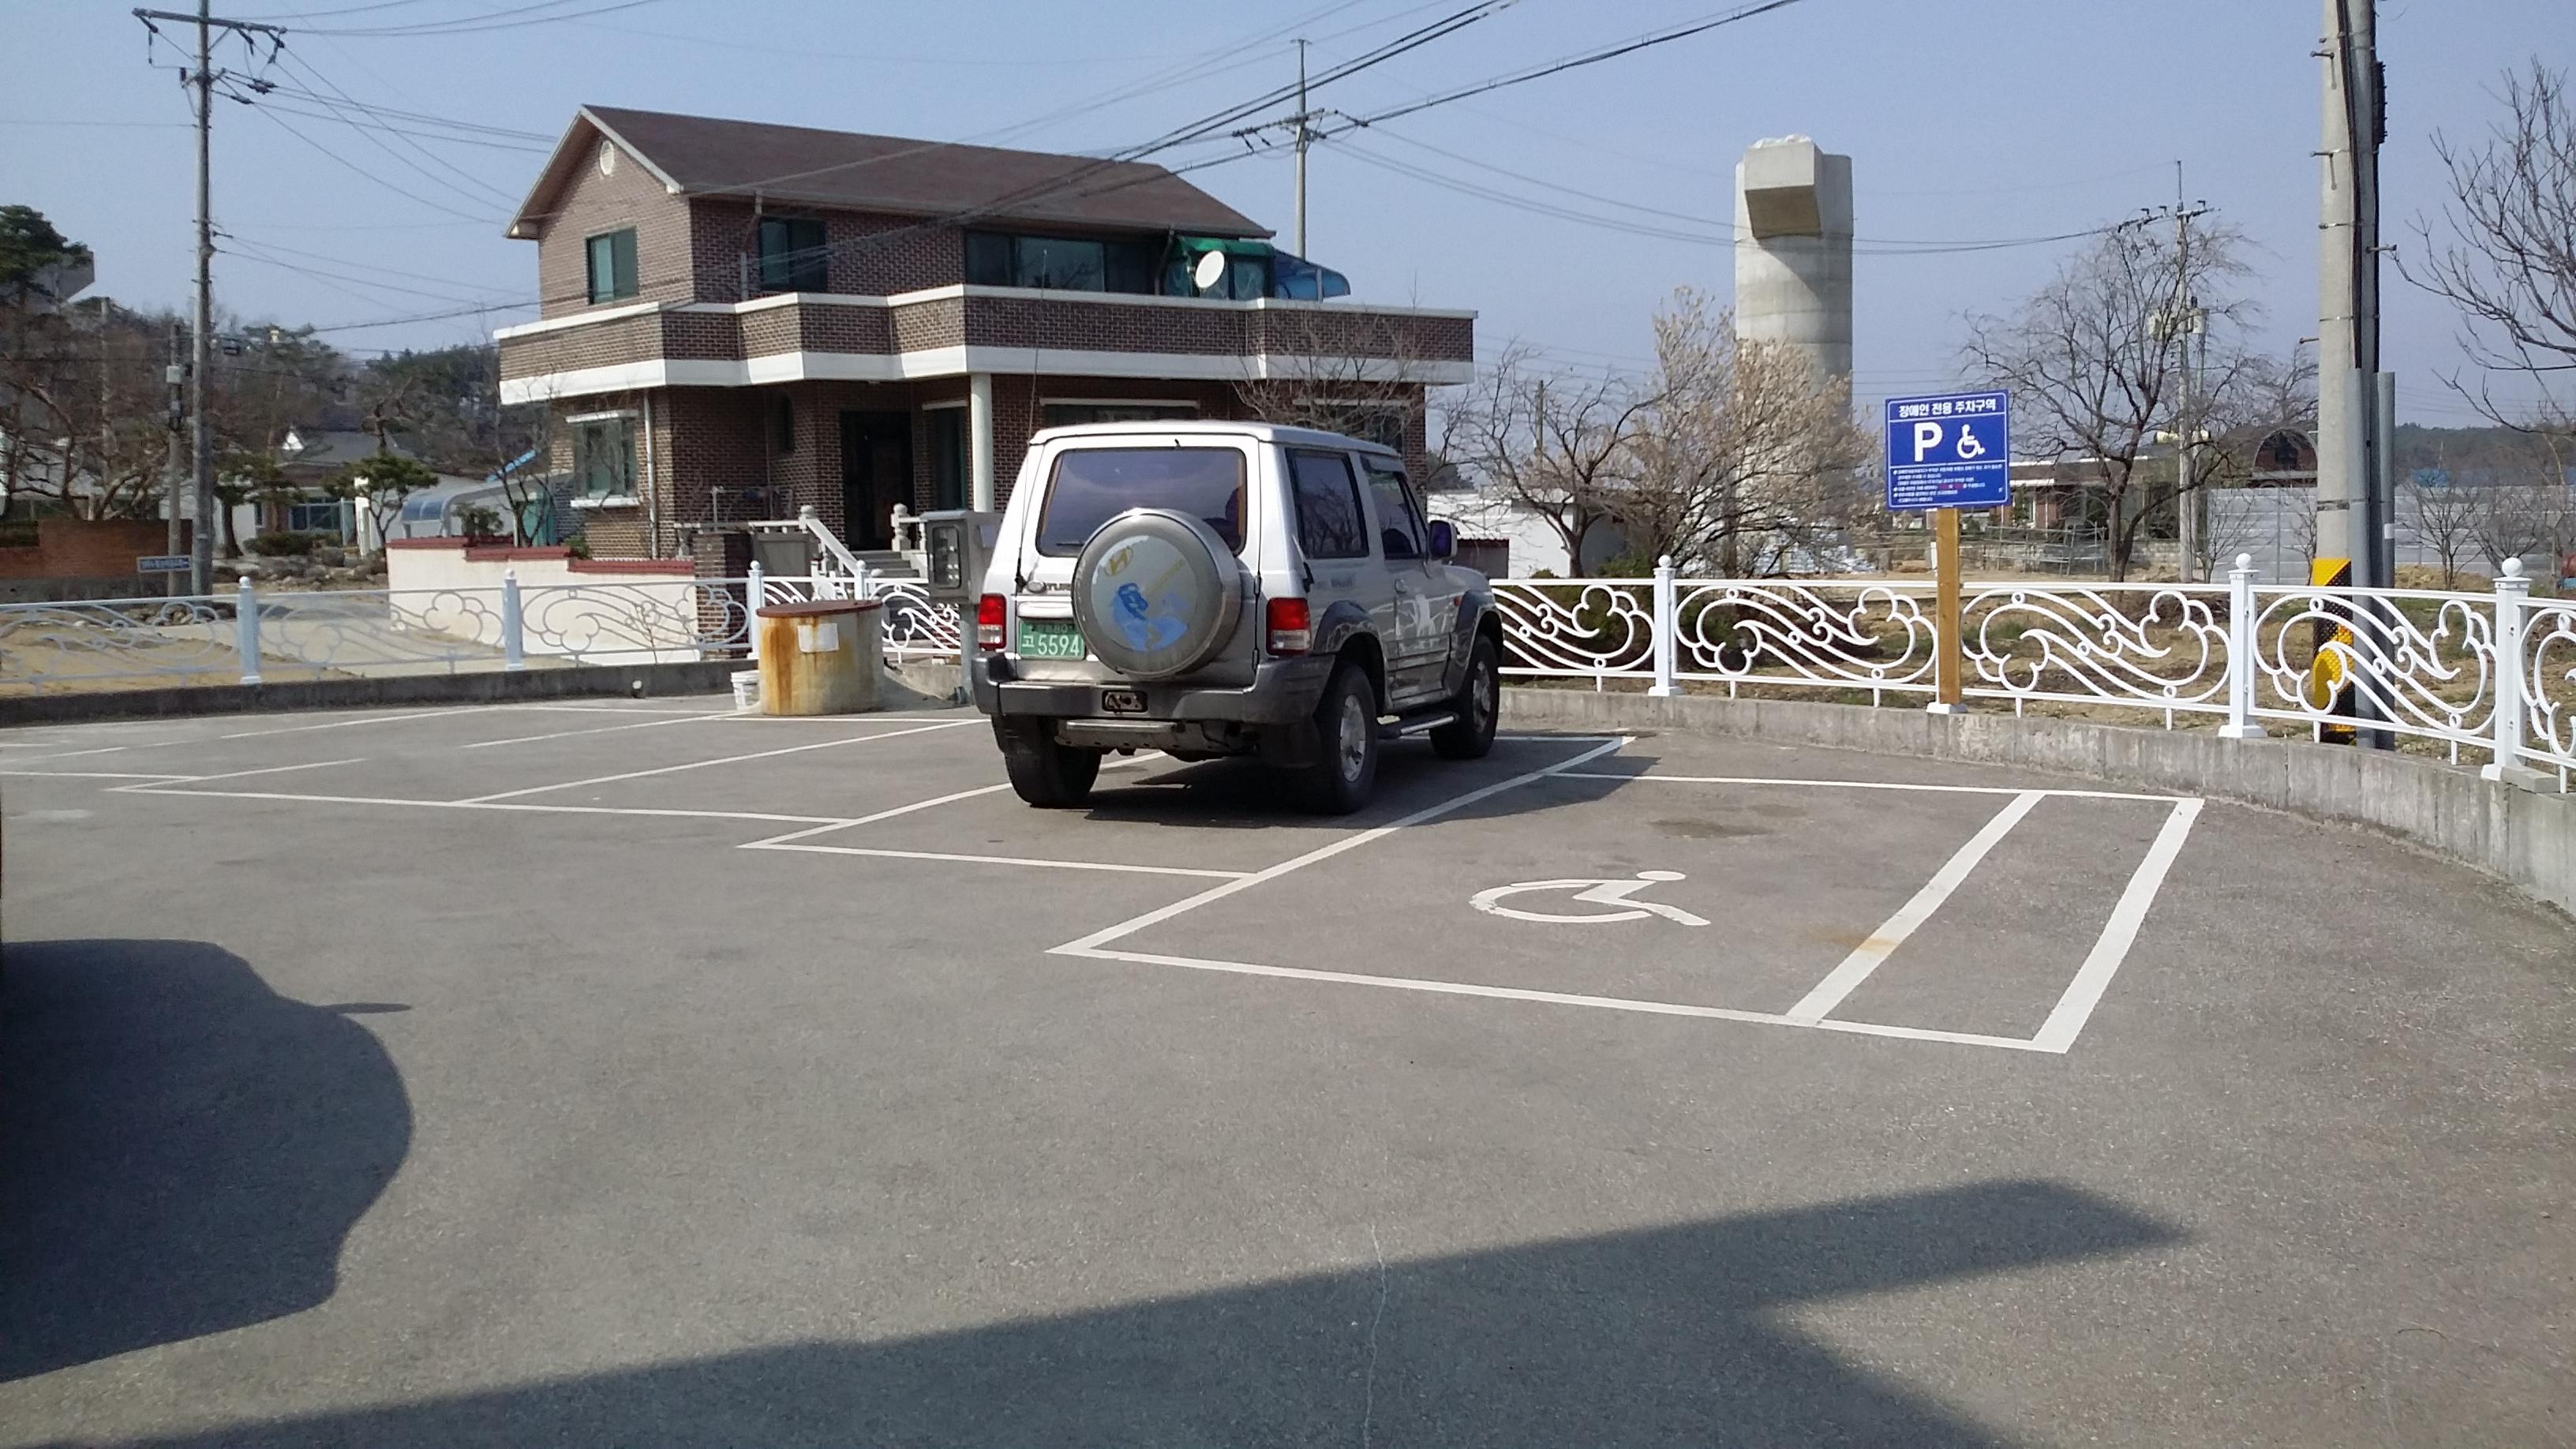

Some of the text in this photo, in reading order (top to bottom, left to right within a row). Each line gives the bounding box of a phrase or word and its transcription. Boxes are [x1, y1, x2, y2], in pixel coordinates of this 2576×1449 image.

[1899, 399, 1997, 417] 장애인 전용 주차구역
[1914, 421, 1943, 462] P
[1037, 635, 1080, 656] 5594
